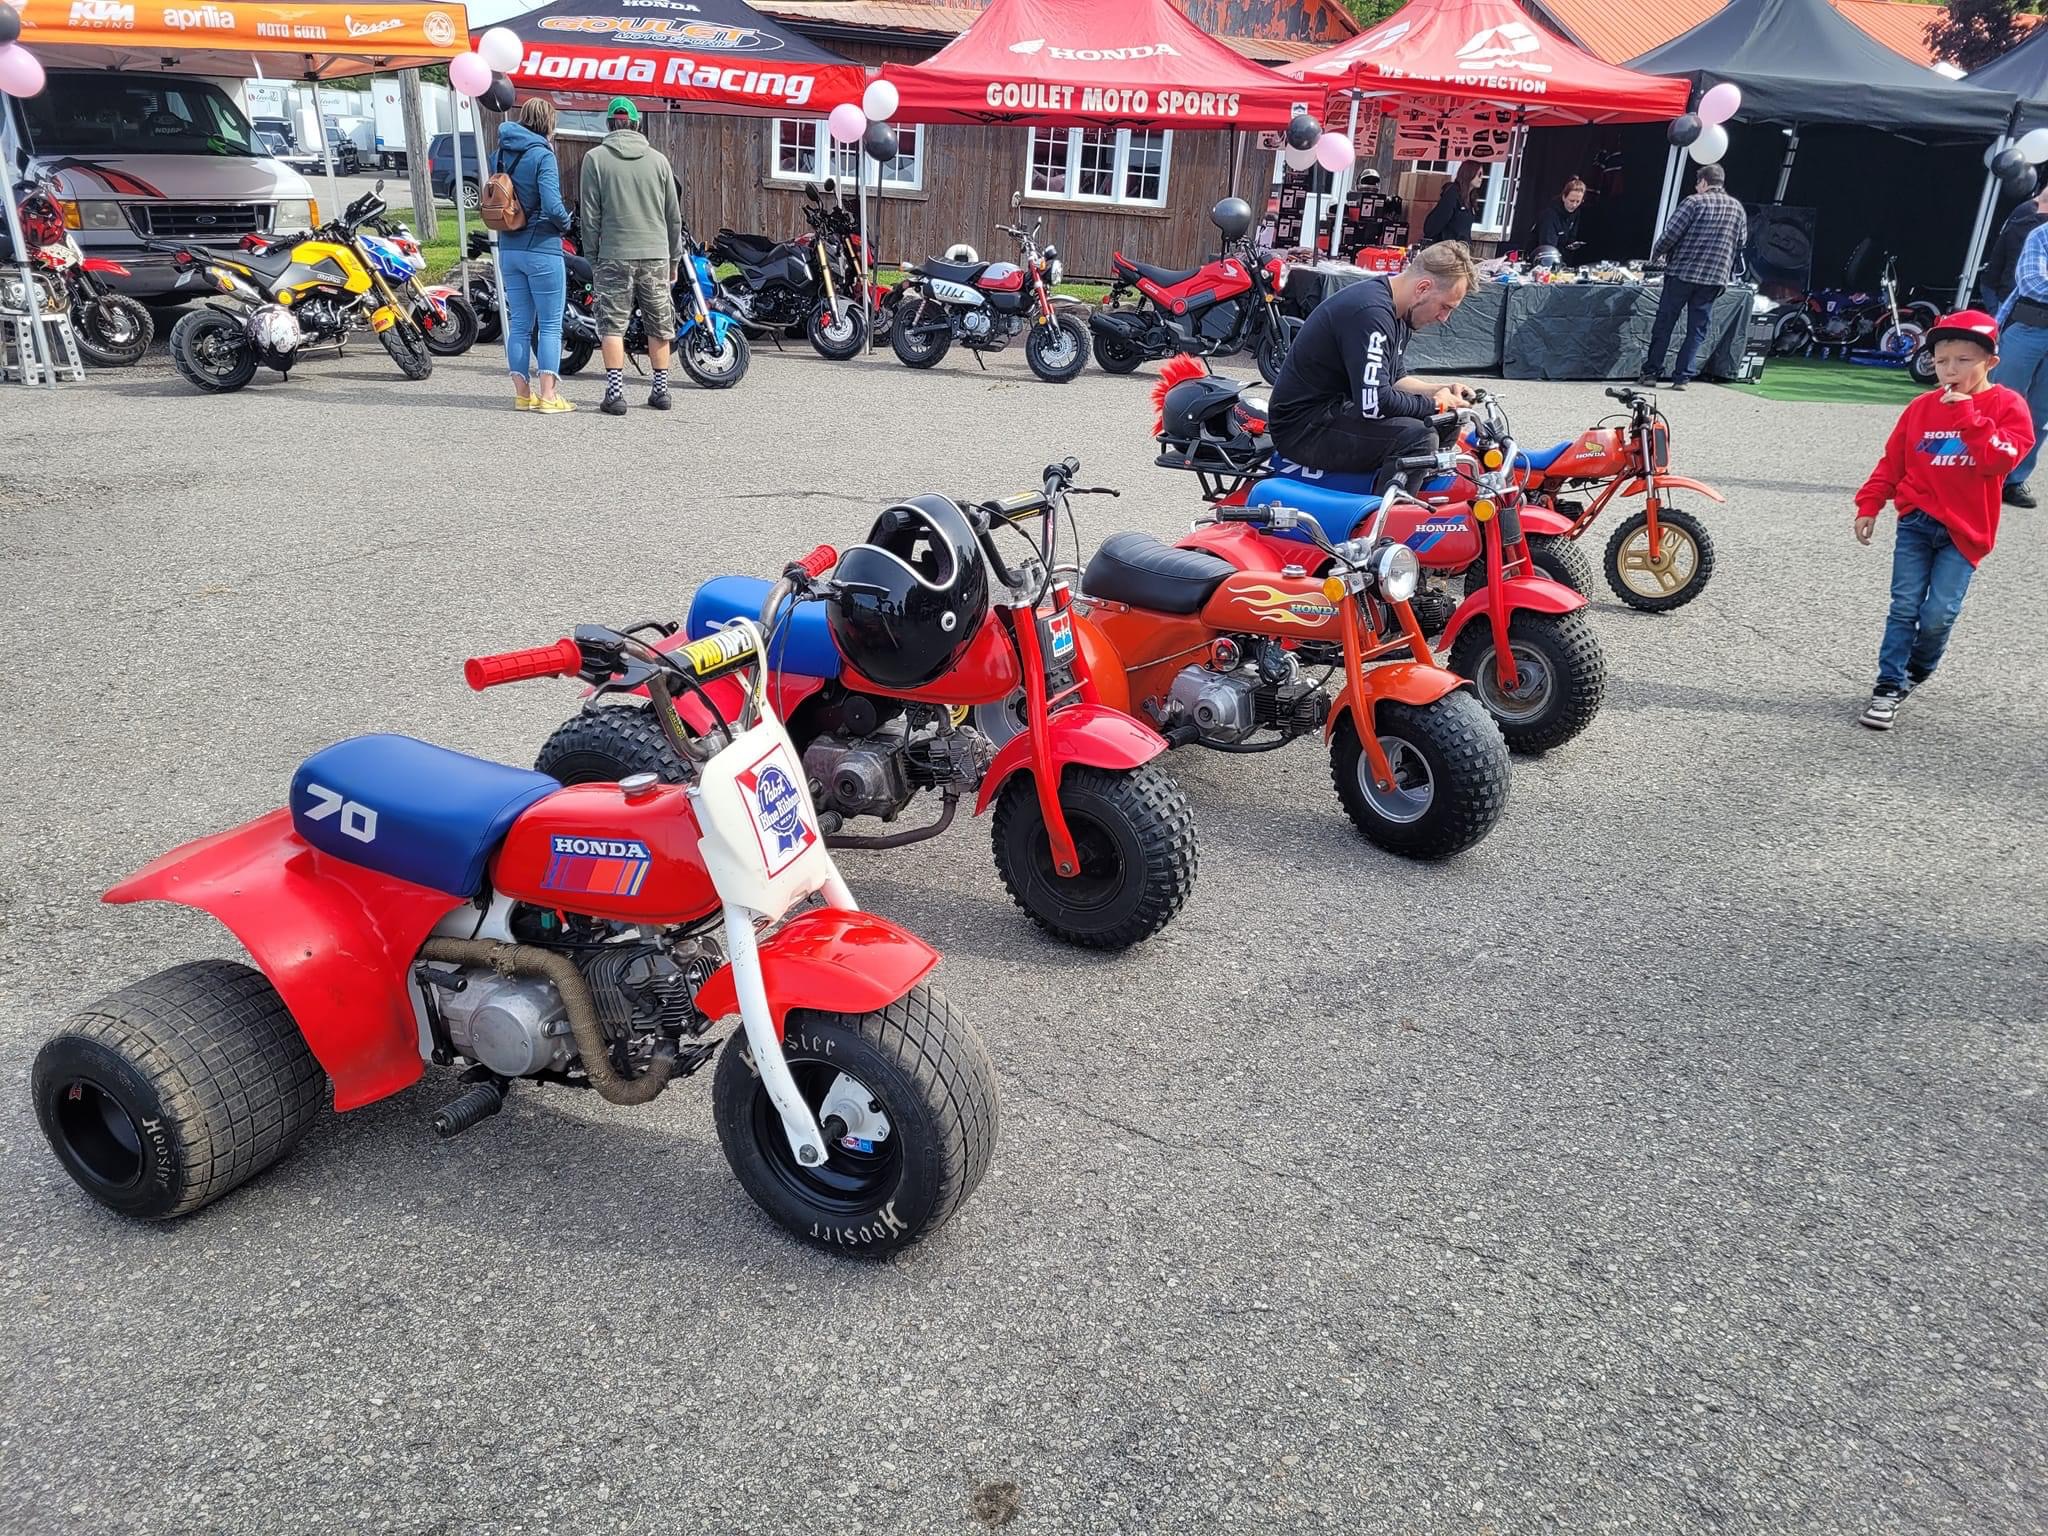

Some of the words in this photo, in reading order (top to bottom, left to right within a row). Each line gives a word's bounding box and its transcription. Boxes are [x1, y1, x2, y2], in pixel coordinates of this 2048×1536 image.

[69, 0, 135, 21] KTM
[622, 0, 701, 12] HONDA
[68, 20, 135, 30] RACING
[163, 5, 235, 30] aprilia
[345, 14, 406, 38] Vespa
[257, 22, 289, 38] MOTO
[294, 25, 327, 39] GUZZI
[540, 16, 758, 42] GOULET
[1048, 43, 1181, 61] HONDA
[507, 51, 656, 82] Honda
[663, 57, 815, 104] Racing
[986, 82, 1075, 110] GOULET
[1081, 87, 1149, 113] MOTO
[1157, 91, 1240, 117] SPORTS
[1575, 451, 1606, 459] HONDA
[1930, 455, 1957, 466] ATC
[1415, 524, 1468, 533] HONDA
[760, 775, 785, 805] Pabst
[304, 783, 378, 843] 70
[760, 809, 780, 831] Blue
[554, 837, 651, 859] HONDA
